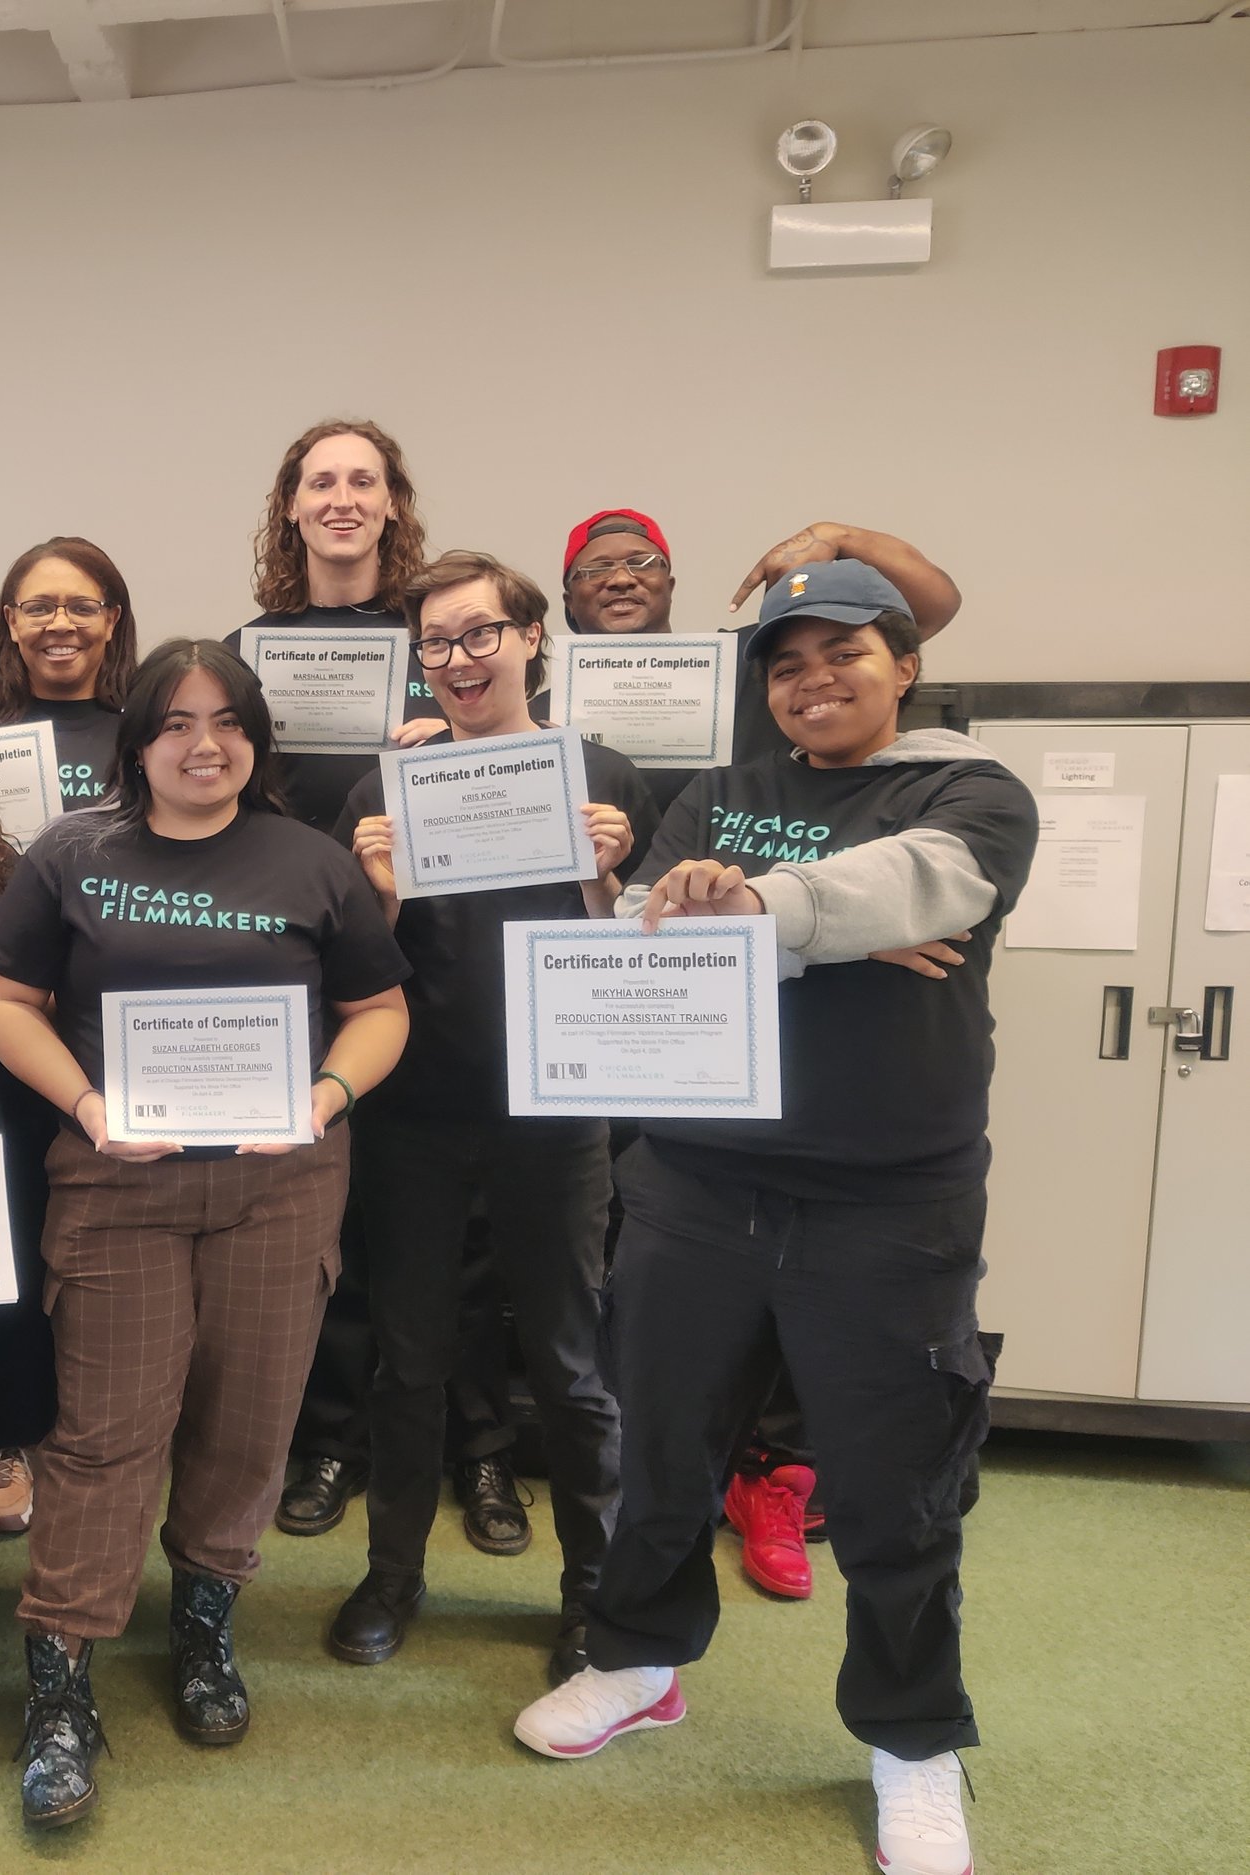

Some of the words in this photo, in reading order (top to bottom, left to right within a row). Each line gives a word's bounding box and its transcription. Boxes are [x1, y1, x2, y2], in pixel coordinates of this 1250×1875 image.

[265, 650, 316, 661] Certificate
[318, 650, 328, 661] of
[330, 651, 385, 663] Completion
[579, 658, 633, 669] Certificate
[636, 658, 648, 669] of
[650, 657, 710, 670] Completion
[613, 681, 642, 689] GERALD
[643, 681, 672, 689] THOMAS
[411, 770, 471, 786] Certificate
[474, 766, 485, 778] of
[488, 758, 555, 777] Completion
[1061, 773, 1096, 782] Lighting
[1, 786, 30, 795] TRAINING
[461, 793, 480, 802] KRIS
[481, 789, 507, 800] KOPAC
[423, 814, 472, 827] PRODUCTION
[473, 808, 513, 821] ASSISTANT
[516, 804, 552, 815] TRAINING
[711, 806, 830, 841] CHICAGO
[715, 833, 855, 864] FILMMA
[81, 877, 214, 908] CHICAGO
[101, 901, 287, 934] FILMMAKERS
[543, 954, 623, 970] Certificate
[628, 953, 644, 969] of
[648, 952, 737, 971] Completion
[591, 988, 632, 998] MIKYHIA
[635, 988, 688, 998] WORSHAM
[133, 1018, 194, 1031] Certificate
[197, 1016, 209, 1029] of
[212, 1015, 279, 1031] Completion
[555, 1013, 620, 1023] PRODUCTION
[622, 1013, 676, 1023] ASSISTANT
[679, 1013, 728, 1023] TRAINING
[152, 1045, 177, 1053] SUZAN
[179, 1043, 221, 1053] ELIZABETH
[222, 1043, 261, 1052] GEORGES
[141, 1065, 191, 1073] PRODUCTION
[192, 1064, 234, 1073] ASSISTANT
[236, 1063, 273, 1072] TRAINING
